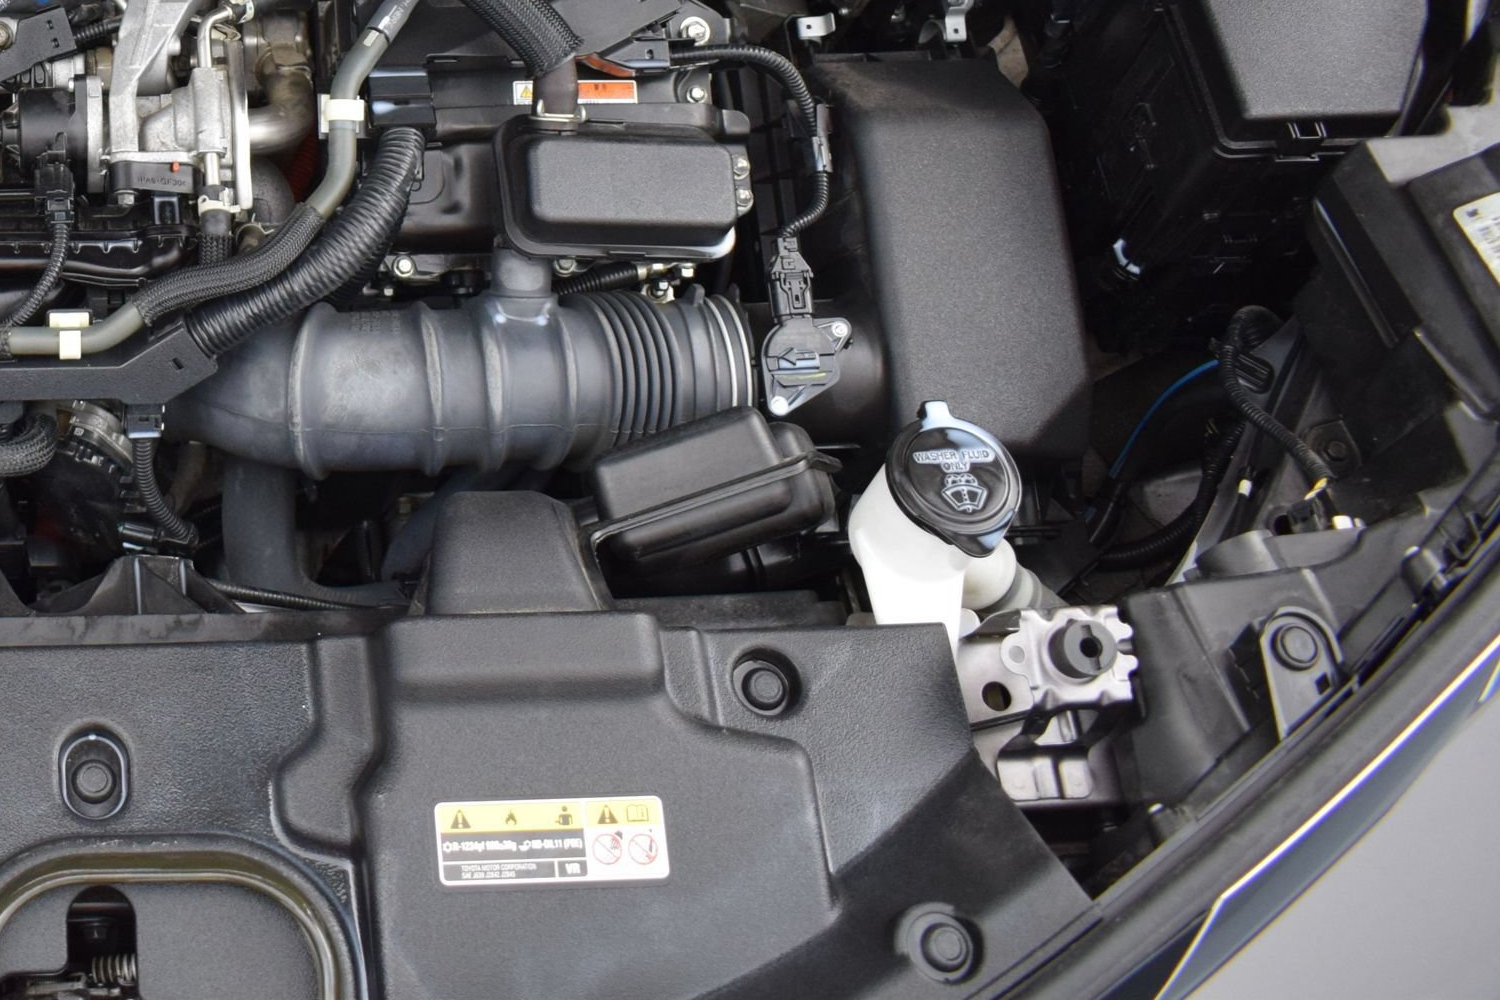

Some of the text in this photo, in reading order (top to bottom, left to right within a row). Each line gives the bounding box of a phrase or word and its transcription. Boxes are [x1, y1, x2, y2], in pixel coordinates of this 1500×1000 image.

[913, 448, 990, 462] WASHER FLUID
[942, 461, 969, 471] ONLY
[461, 863, 537, 872] TOYOTA MOTOR CORPORATION
[565, 862, 581, 875] VR
